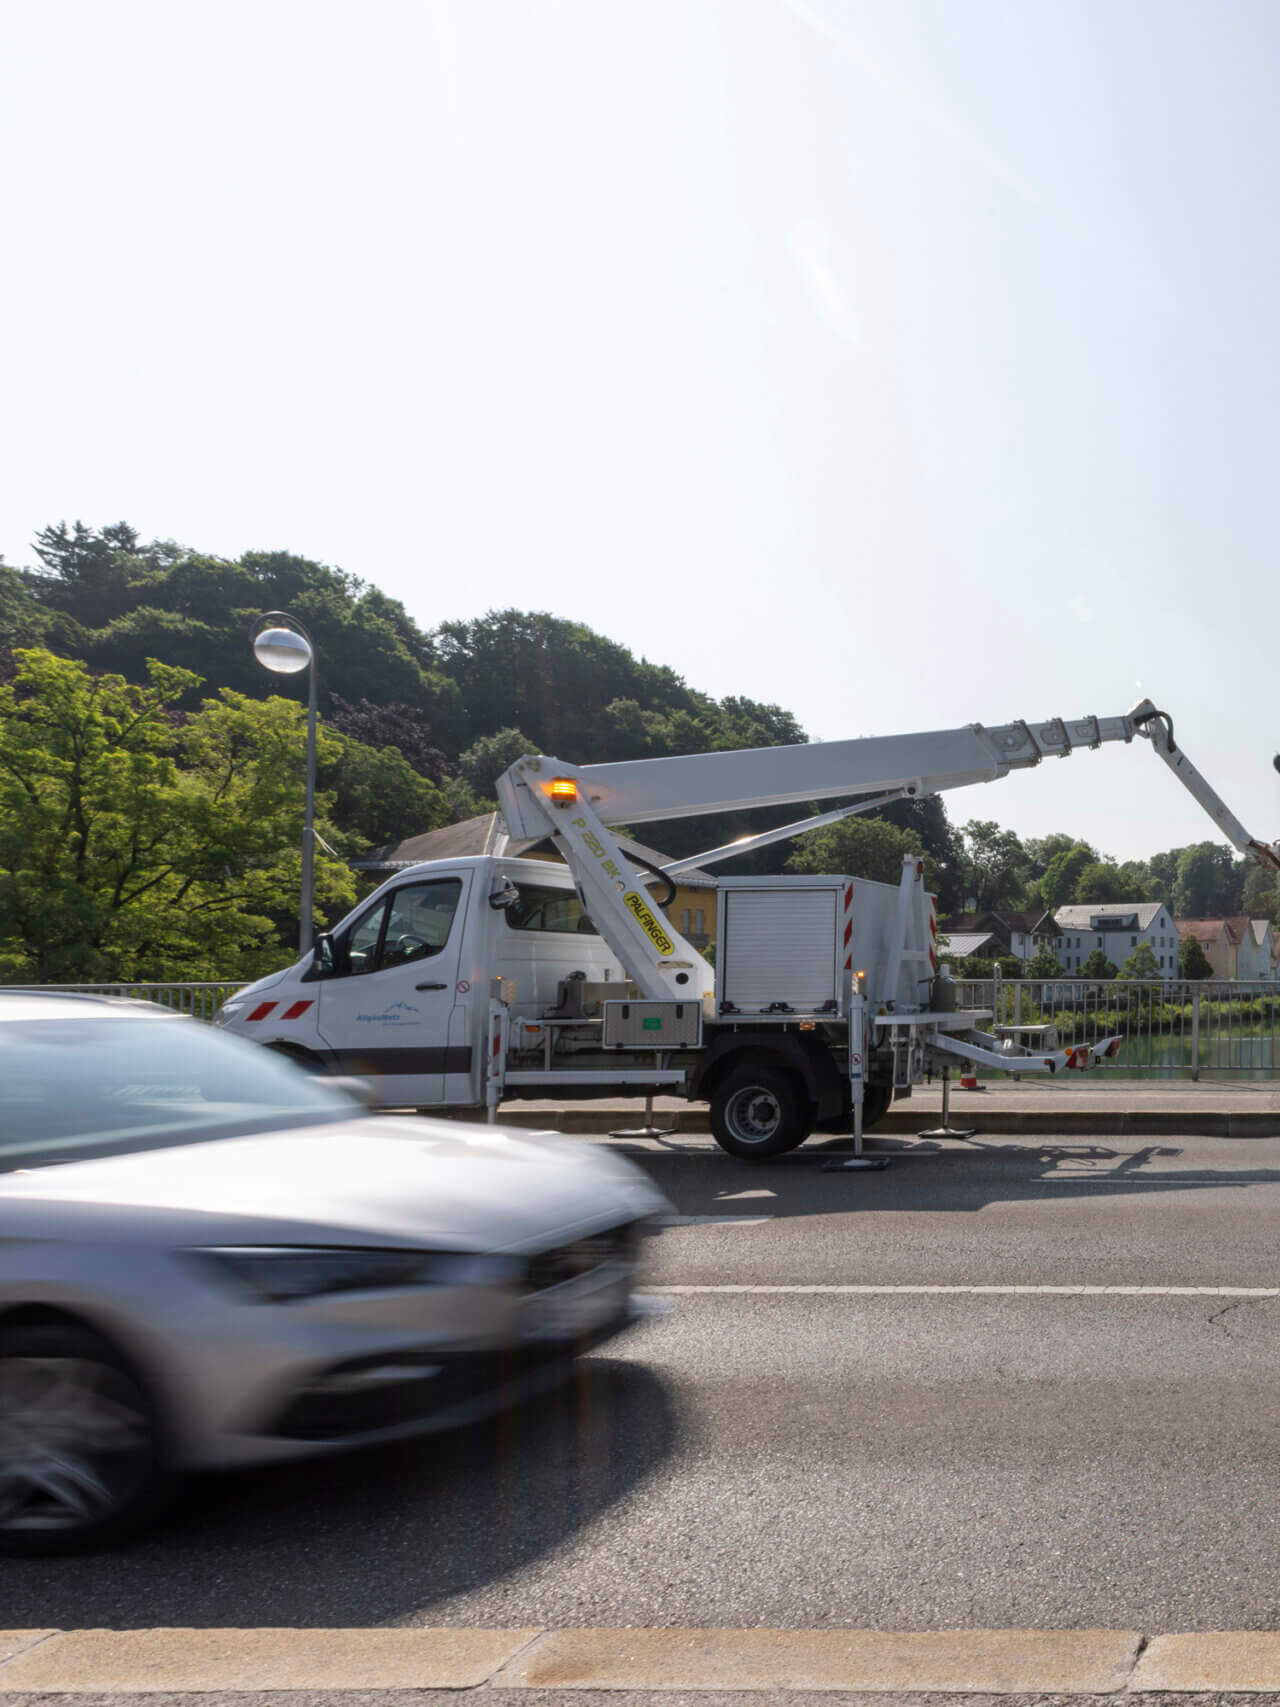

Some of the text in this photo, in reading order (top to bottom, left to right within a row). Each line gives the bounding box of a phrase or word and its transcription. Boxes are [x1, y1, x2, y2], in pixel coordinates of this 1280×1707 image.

[572, 817, 621, 879] P 220 BK
[626, 895, 672, 953] PALFINGER
